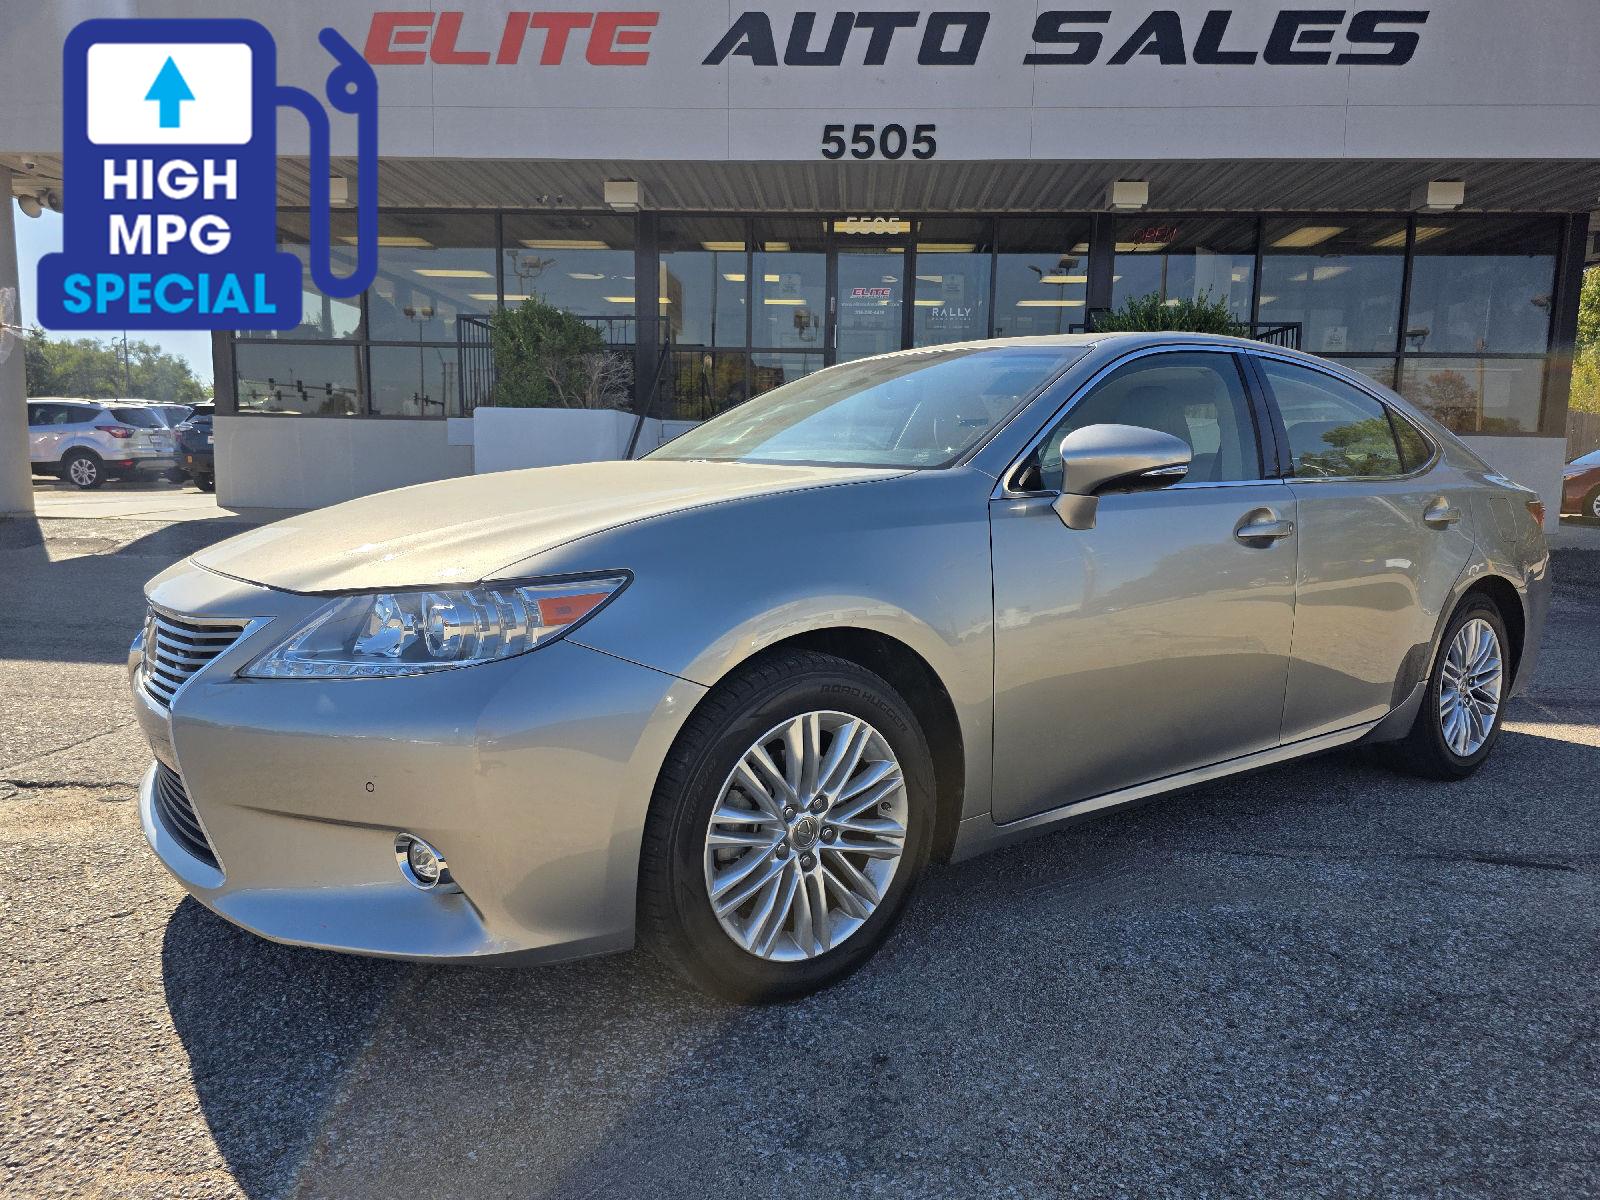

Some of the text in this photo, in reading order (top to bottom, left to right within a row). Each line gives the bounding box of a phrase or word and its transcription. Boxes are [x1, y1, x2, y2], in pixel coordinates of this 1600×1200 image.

[365, 10, 1431, 67] ELITE AUTO SALES
[821, 123, 937, 160] 5505
[851, 287, 891, 297] ELITE
[932, 307, 971, 317] RALLY
[820, 684, 861, 697] ROAD
